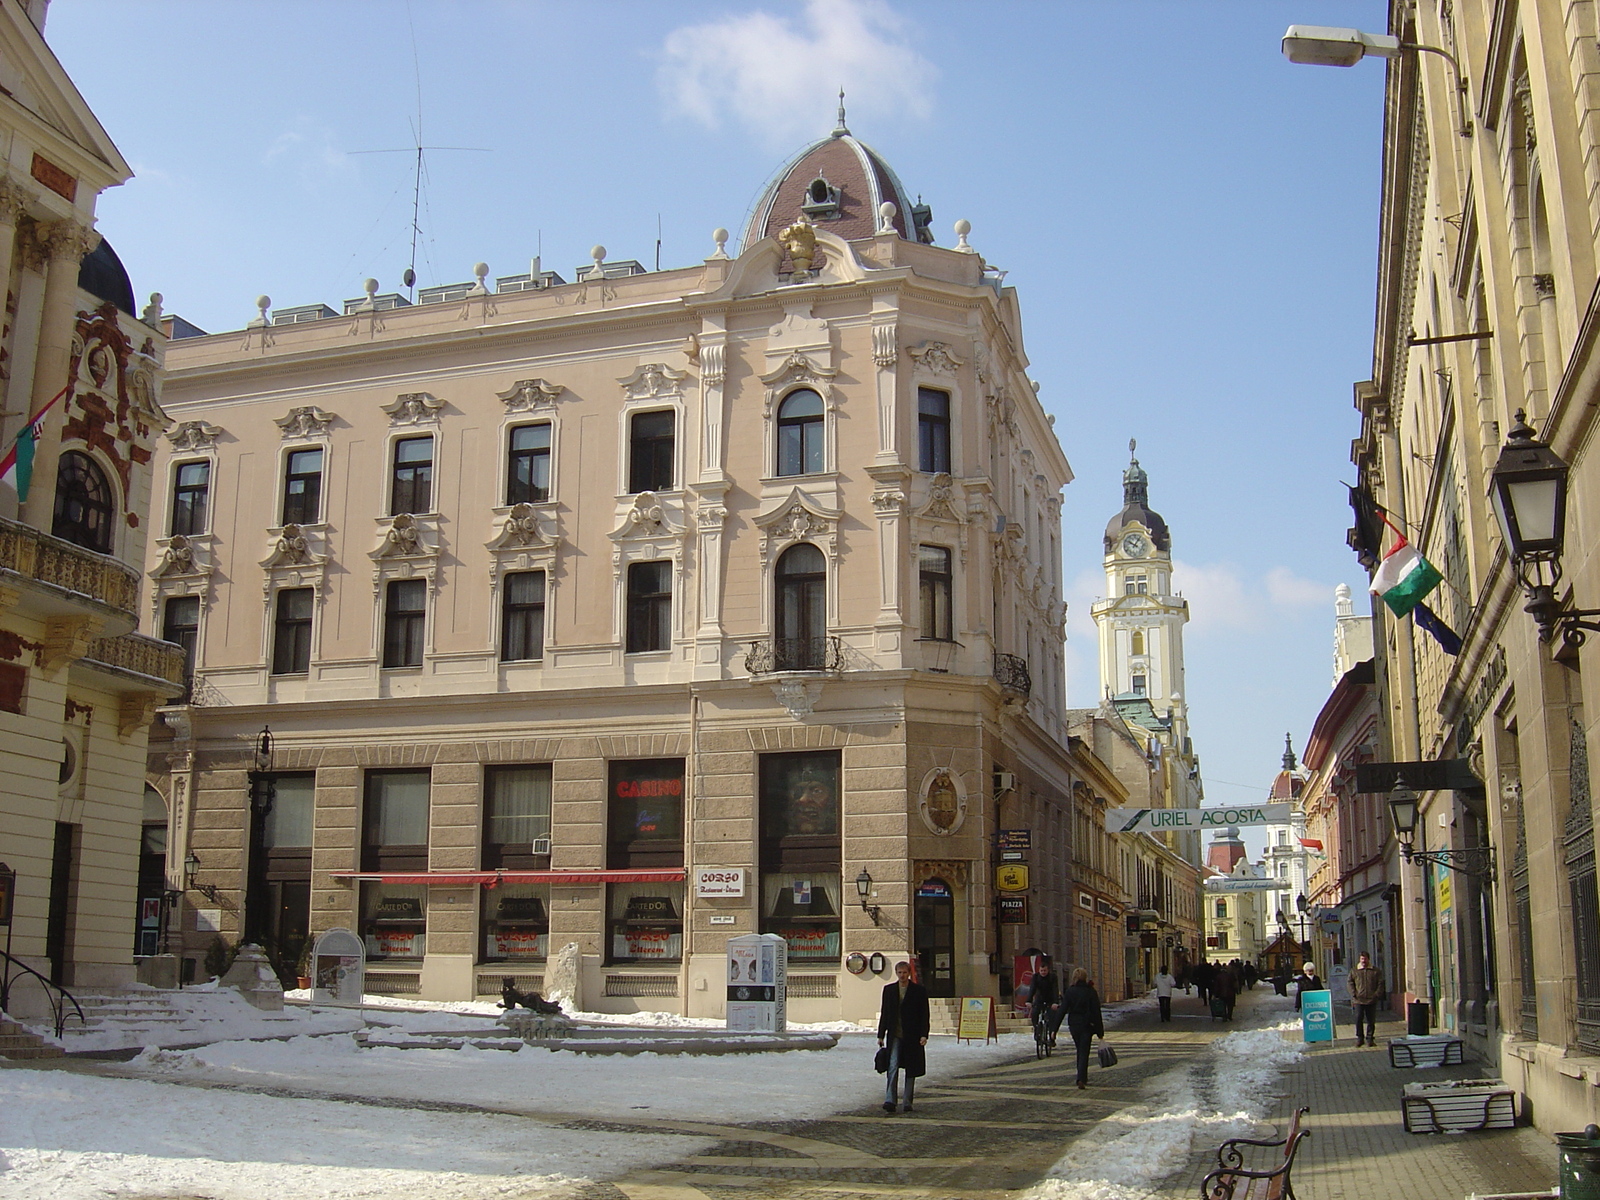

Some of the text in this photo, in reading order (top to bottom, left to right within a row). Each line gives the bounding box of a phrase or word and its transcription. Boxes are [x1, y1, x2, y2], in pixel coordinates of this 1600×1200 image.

[616, 779, 682, 798] CASINO
[1151, 811, 1192, 828] URIEL
[1200, 808, 1266, 825] ACOSTA
[701, 873, 739, 883] CORSO
[625, 930, 670, 942] CORSO
[776, 980, 784, 1015] Nemzeti
